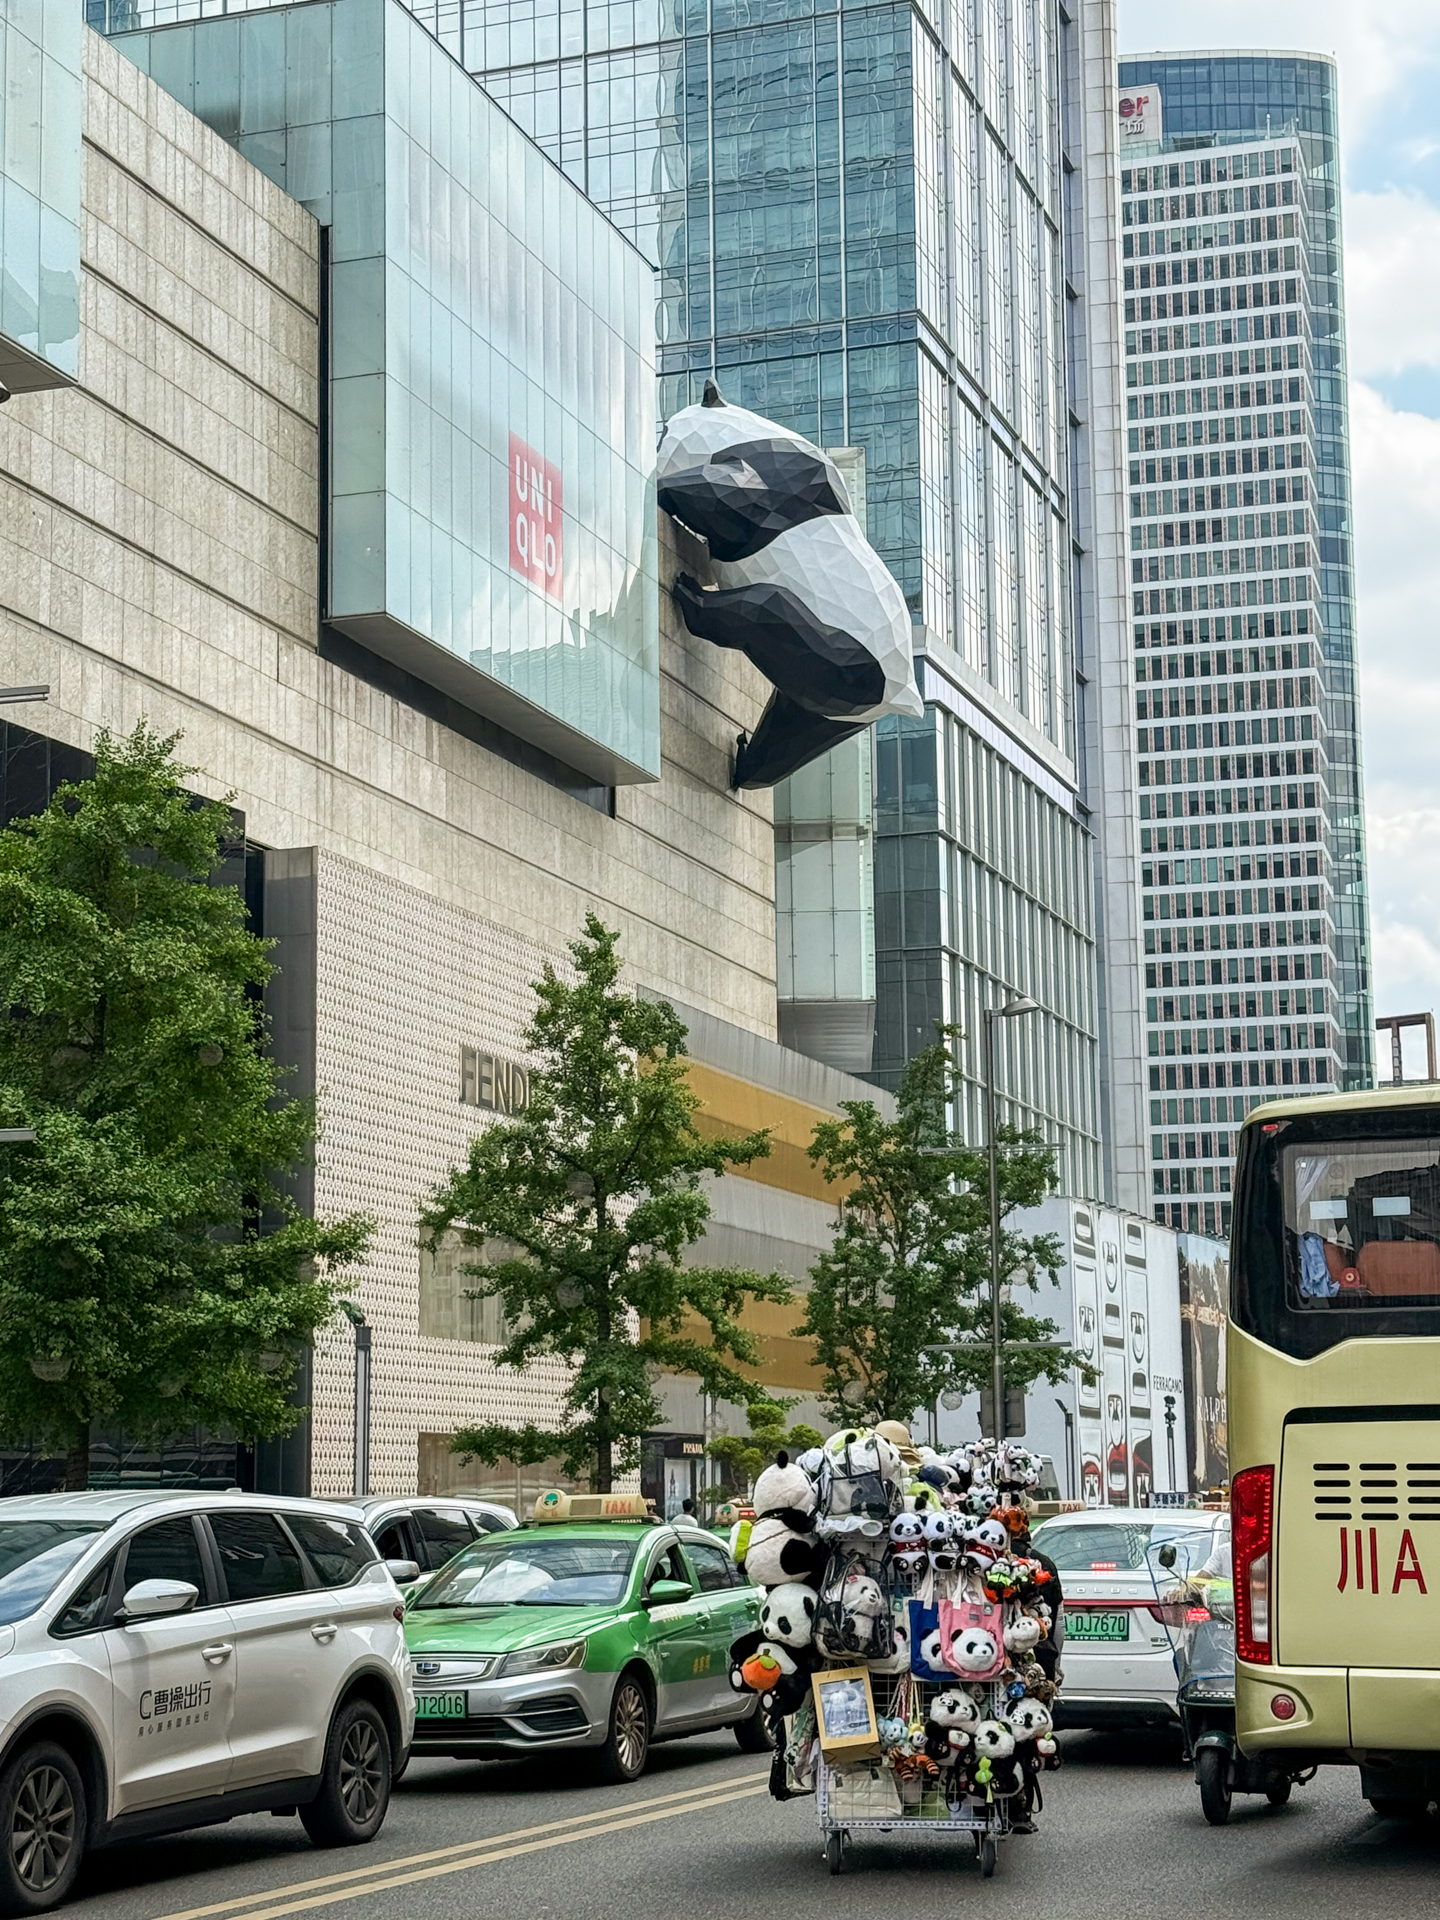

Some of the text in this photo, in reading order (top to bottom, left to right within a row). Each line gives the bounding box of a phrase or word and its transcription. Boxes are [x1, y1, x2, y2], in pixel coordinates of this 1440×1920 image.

[515, 454, 553, 523] UNI
[516, 512, 557, 577] QLO
[1153, 1374, 1183, 1394] FERRAGAMO
[604, 1500, 632, 1514] TAXI
[1061, 1503, 1082, 1513] TAXI
